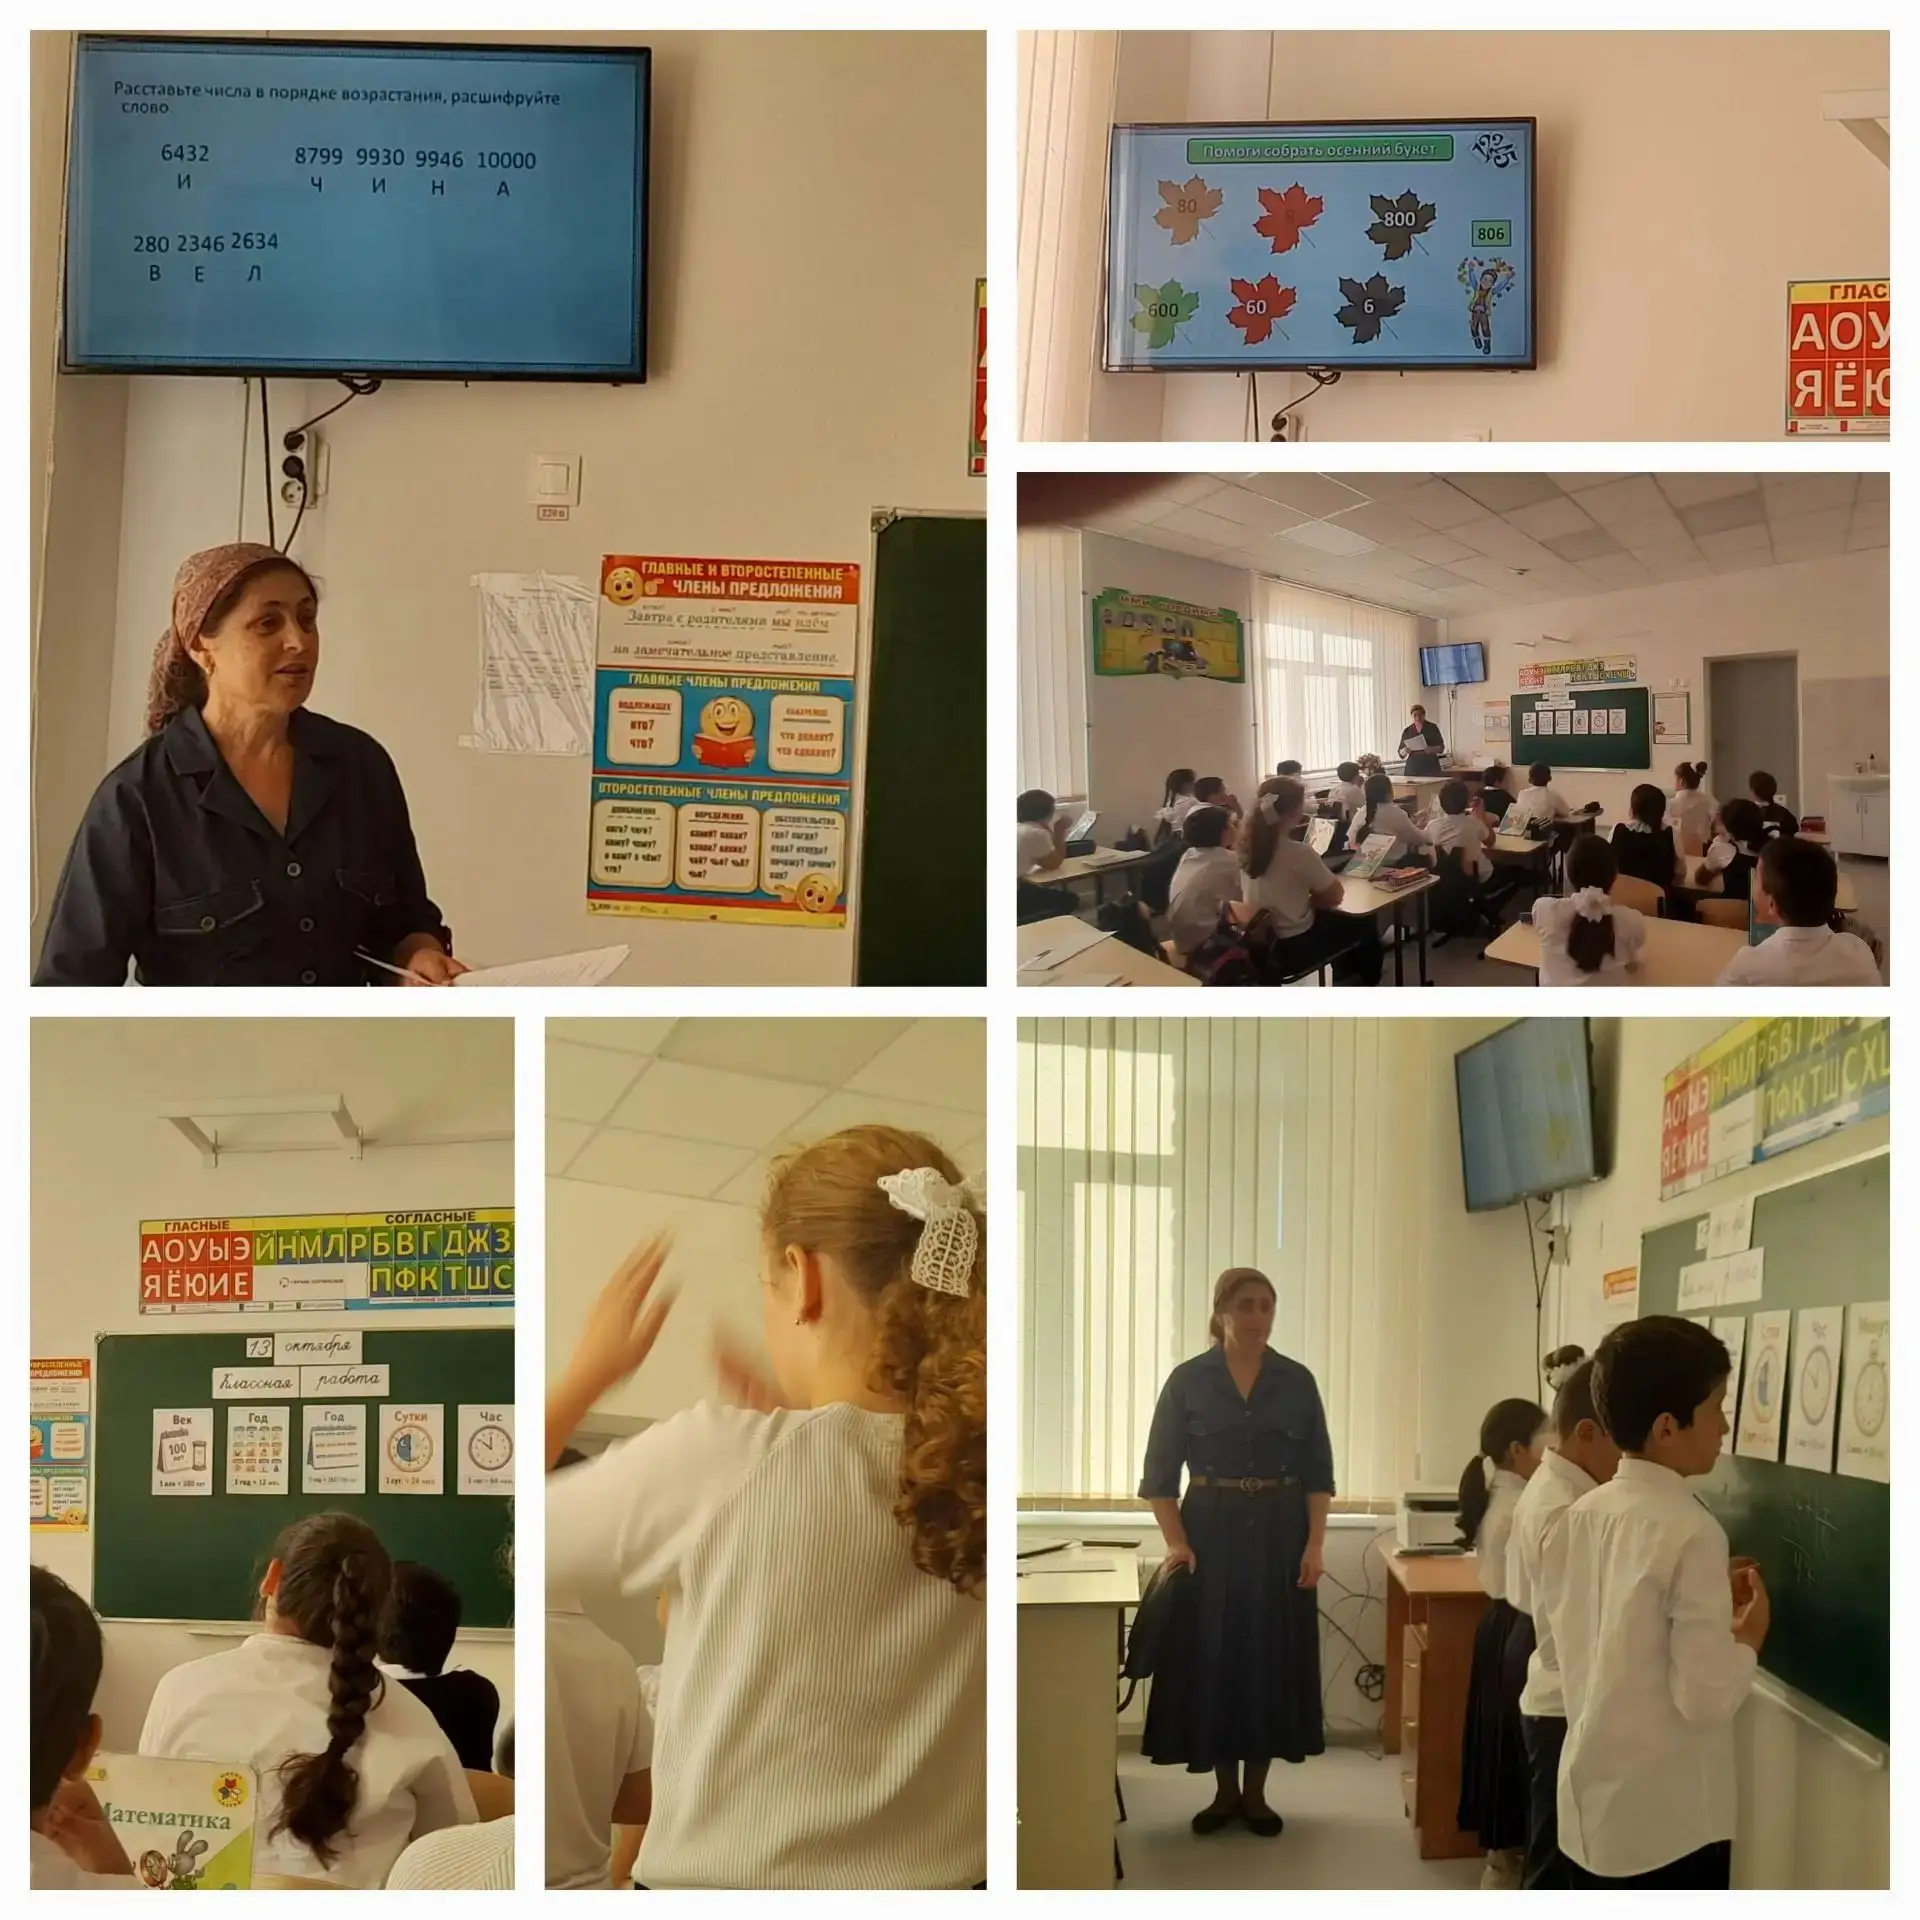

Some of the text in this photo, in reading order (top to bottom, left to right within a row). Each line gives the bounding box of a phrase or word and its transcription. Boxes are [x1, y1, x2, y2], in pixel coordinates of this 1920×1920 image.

[114, 81, 561, 107] Расставьте числа в порядке возрастания, расшифруйте
[122, 102, 169, 114] слово
[161, 144, 537, 169] 6432 8799 9930 9946 10000
[1203, 142, 1436, 160] Помоги собрать осенний букет
[177, 174, 510, 196] И Ч И Н А
[1177, 199, 1198, 213] 80
[1384, 211, 1416, 227] 800
[133, 232, 278, 253] 280 2346 2634
[1477, 228, 1505, 240] 806
[150, 265, 262, 282] В Е Л
[1830, 283, 1890, 300] ГЛАС
[1148, 299, 1374, 318] 600 60 6
[642, 561, 704, 577] ГЛАВНЫЕ
[721, 564, 843, 580] ВТОРОСТЕПЕННЫЕ
[673, 579, 842, 598] ЧЛЕНЫ ПРЕДЛОЖЕНИЯ
[628, 609, 672, 623] Завтра
[629, 673, 820, 692] ГЛАВНЫЕ ЧЛЕНЫ ПРЕДЛОЖЕНИЯ
[599, 782, 840, 806] ВТОРОСТЕПЕННЫЕ ЧЛЕНЫ ПРЕДЛОЖЕНИЯ
[164, 1211, 476, 1232] ГЛАСНЫЕ СОГЛАСНЫЕ
[249, 1334, 352, 1359] 13 октября
[218, 1367, 381, 1391] Классная работа
[173, 1414, 192, 1425] Век
[248, 1412, 268, 1424] Год
[324, 1411, 345, 1422] Год
[394, 1410, 428, 1423] Сутки
[480, 1411, 503, 1421] Час
[169, 1442, 187, 1455] 100
